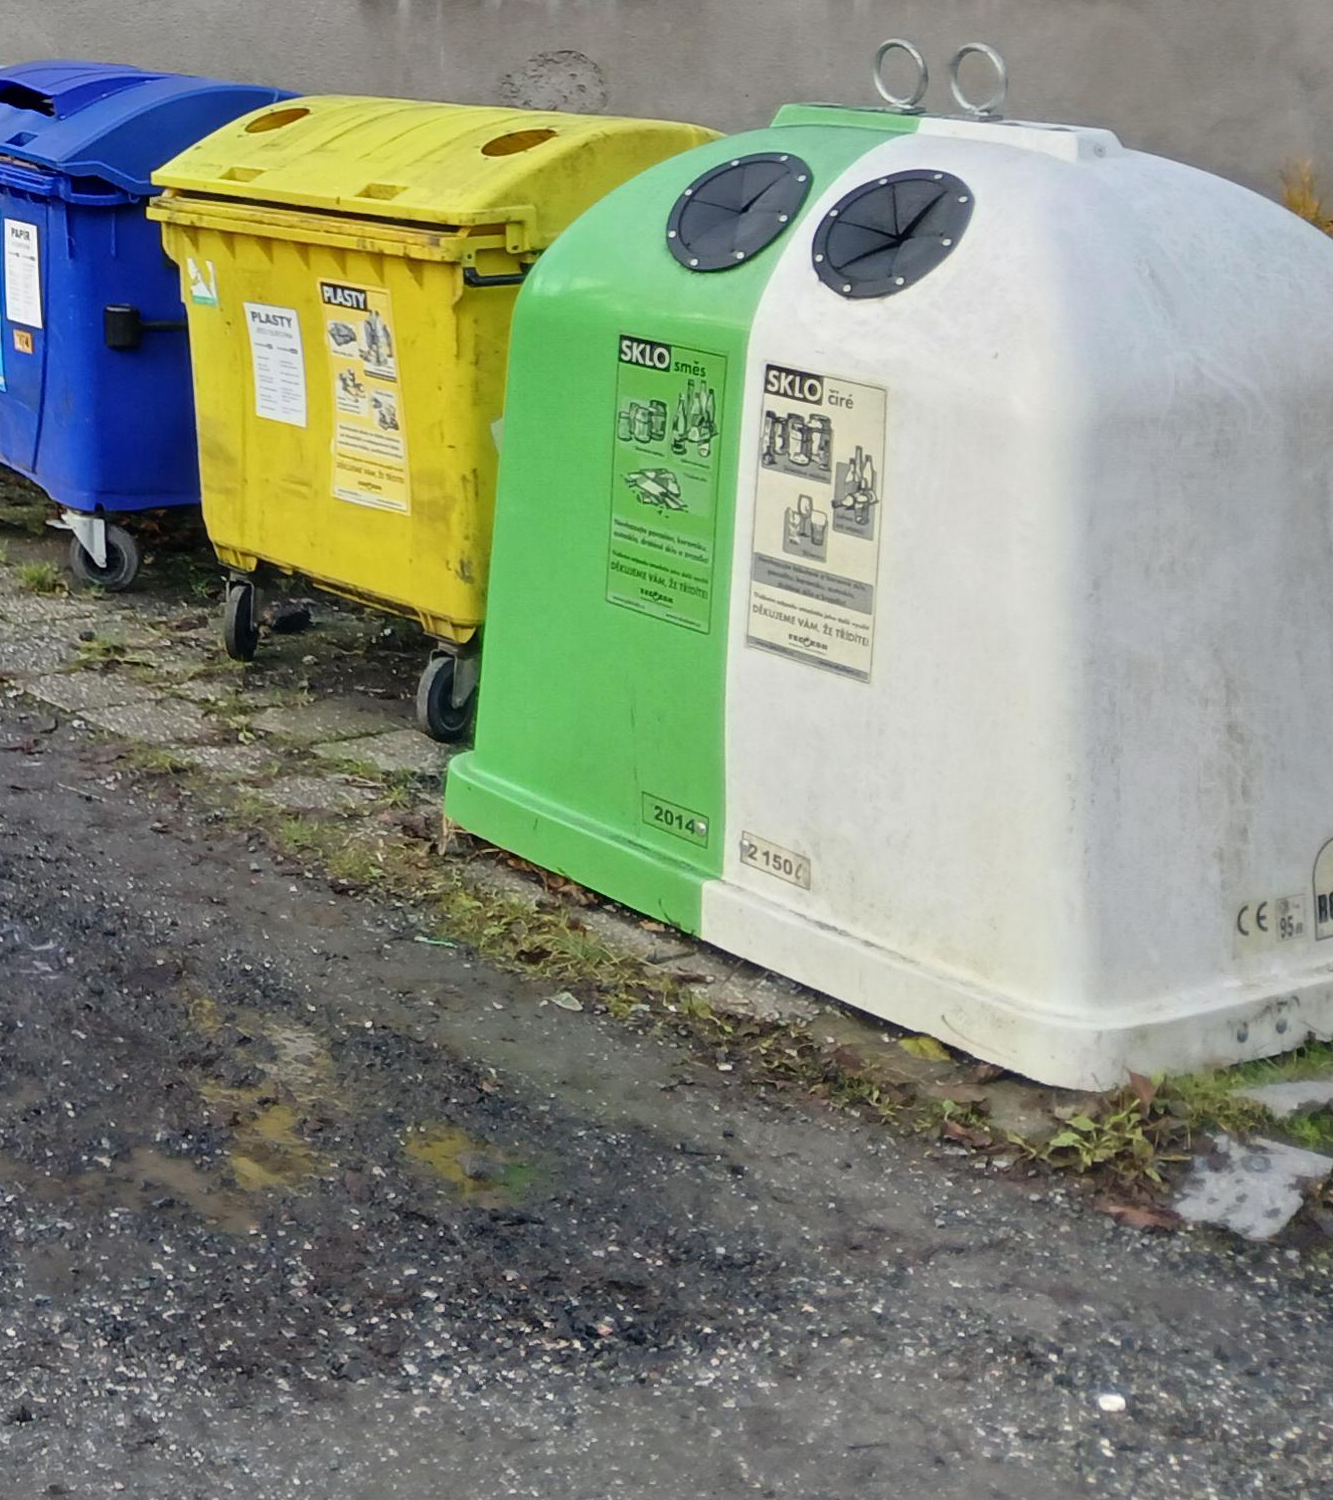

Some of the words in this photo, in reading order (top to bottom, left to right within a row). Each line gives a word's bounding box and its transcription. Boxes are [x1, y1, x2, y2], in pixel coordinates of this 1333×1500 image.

[322, 285, 366, 309] PLASTY
[250, 311, 293, 328] PLASTY
[620, 340, 670, 369] SKLO
[674, 361, 707, 377] směs
[766, 370, 822, 402] SKLO
[752, 603, 796, 627] DĚKUJEME
[821, 622, 834, 636] ŽE
[653, 805, 696, 835] 2014
[761, 850, 794, 876] 150
